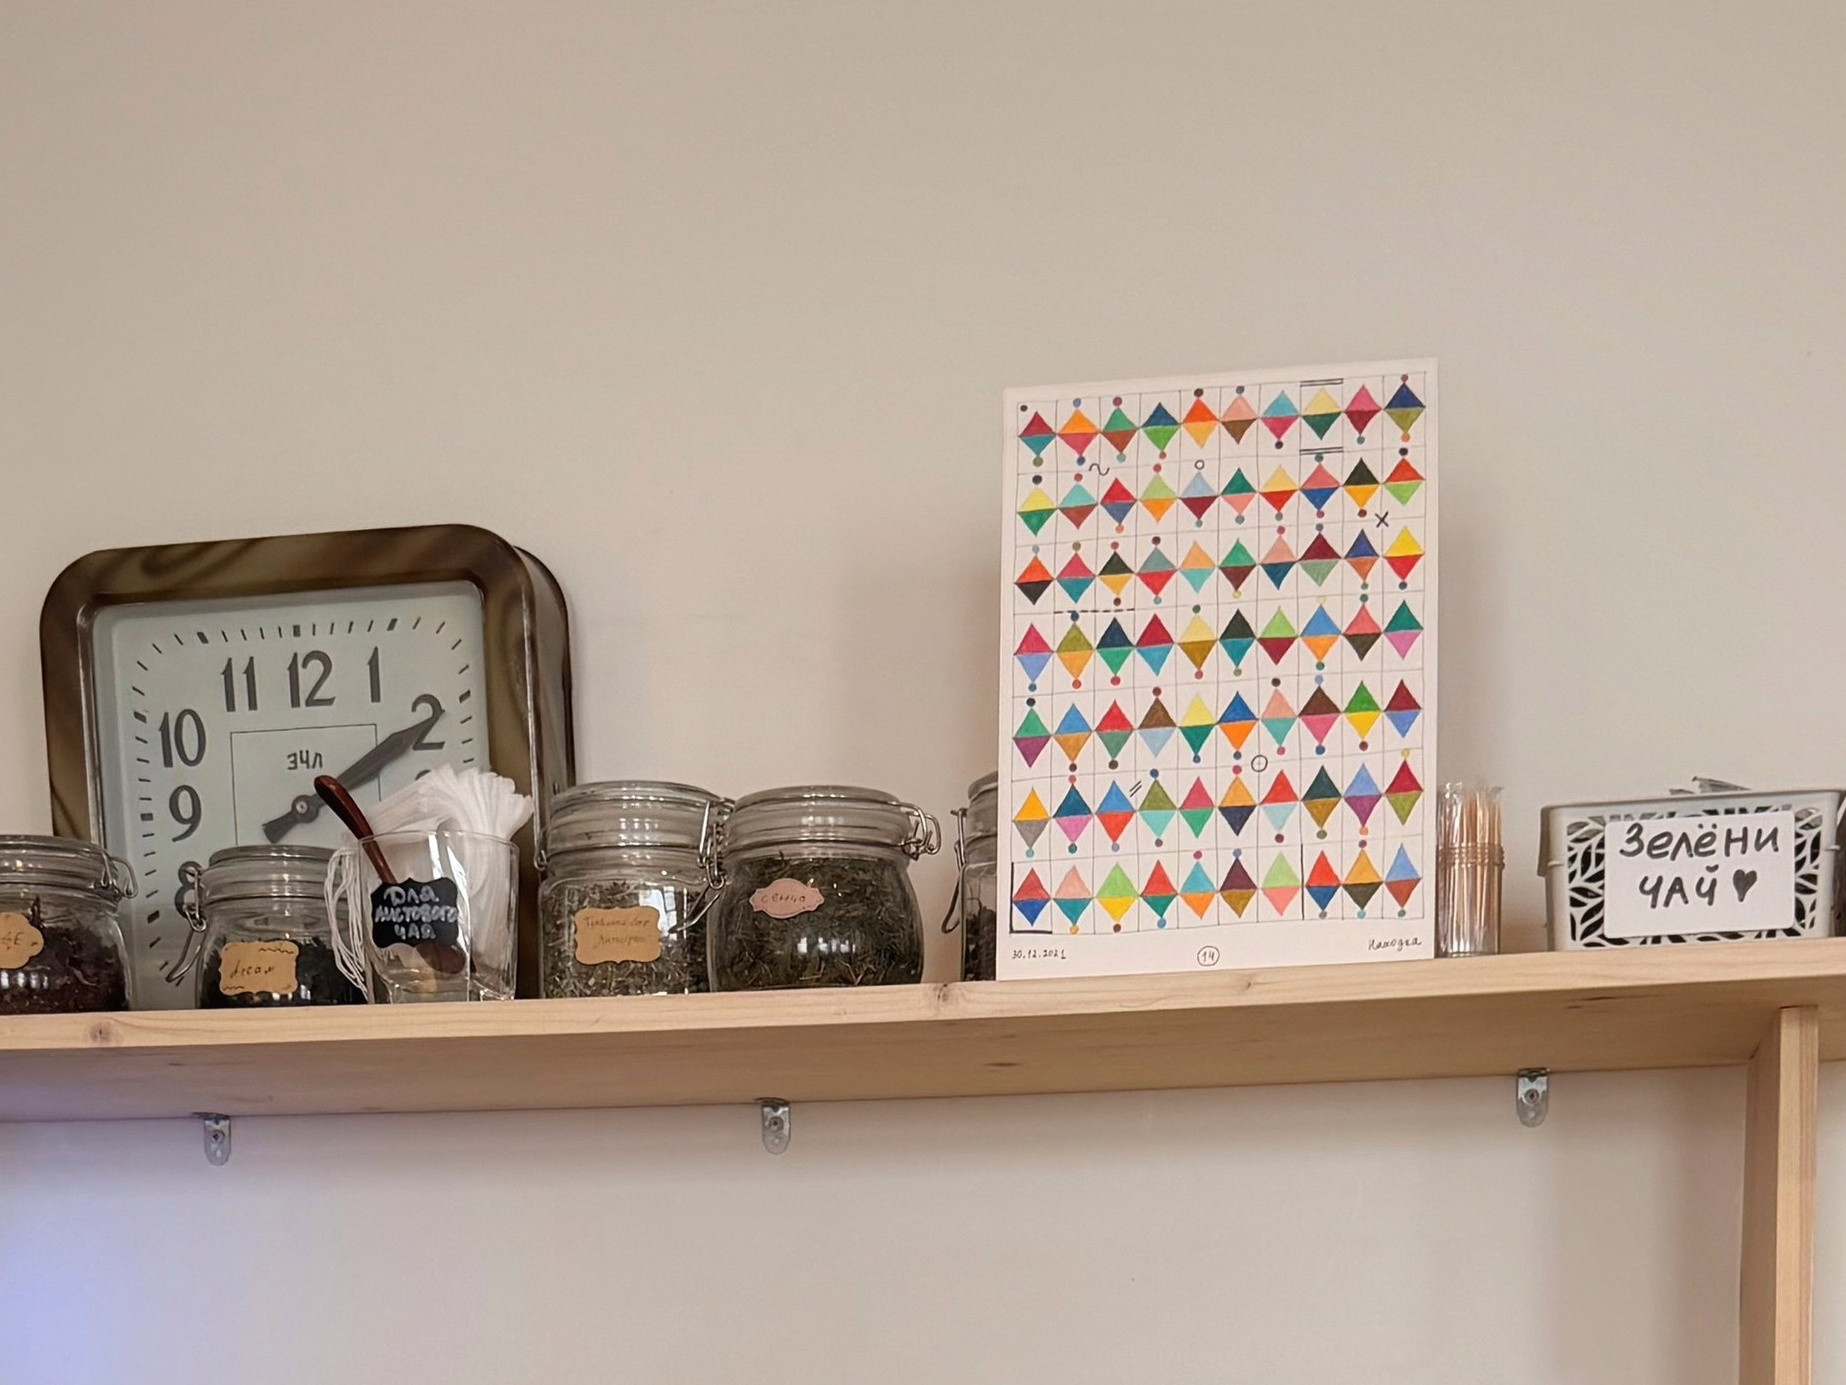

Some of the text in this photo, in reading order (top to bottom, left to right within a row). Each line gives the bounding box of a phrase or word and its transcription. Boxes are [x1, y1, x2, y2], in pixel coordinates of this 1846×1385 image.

[221, 655, 258, 713] 11
[286, 649, 336, 709] 12
[367, 645, 382, 703] 1
[158, 707, 207, 769] 10
[411, 693, 445, 751] 2
[169, 784, 202, 843] 9
[1012, 949, 1066, 960] 30.12.2021
